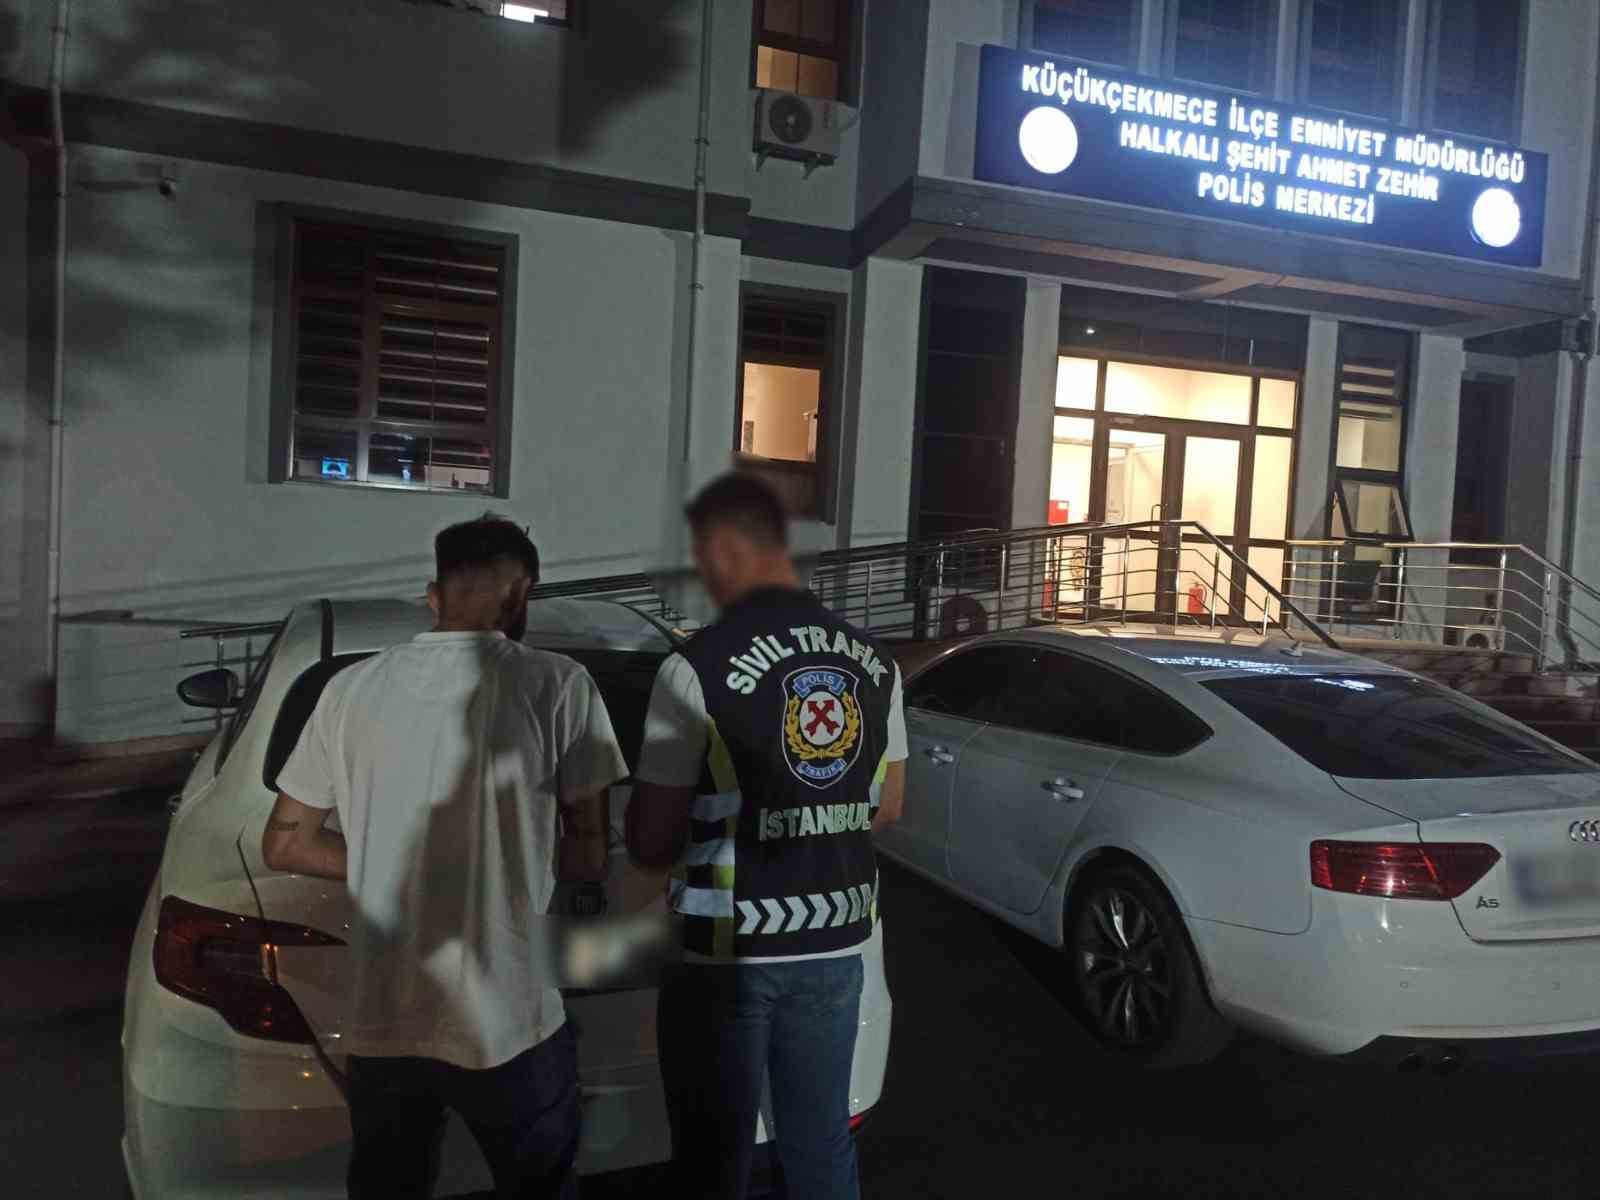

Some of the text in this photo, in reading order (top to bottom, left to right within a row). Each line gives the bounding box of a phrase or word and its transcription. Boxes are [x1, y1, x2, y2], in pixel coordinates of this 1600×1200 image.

[1021, 61, 1525, 184] KÜÇÜKÇEKMECE İLÇE EMNİYET MÜDÜRLÜĞÜ
[1119, 121, 1440, 202] HALKALI ŞEHİT AHMET ZEHİR
[1198, 171, 1375, 224] POLİS MERKEZİ
[726, 634, 796, 695] SİVİL
